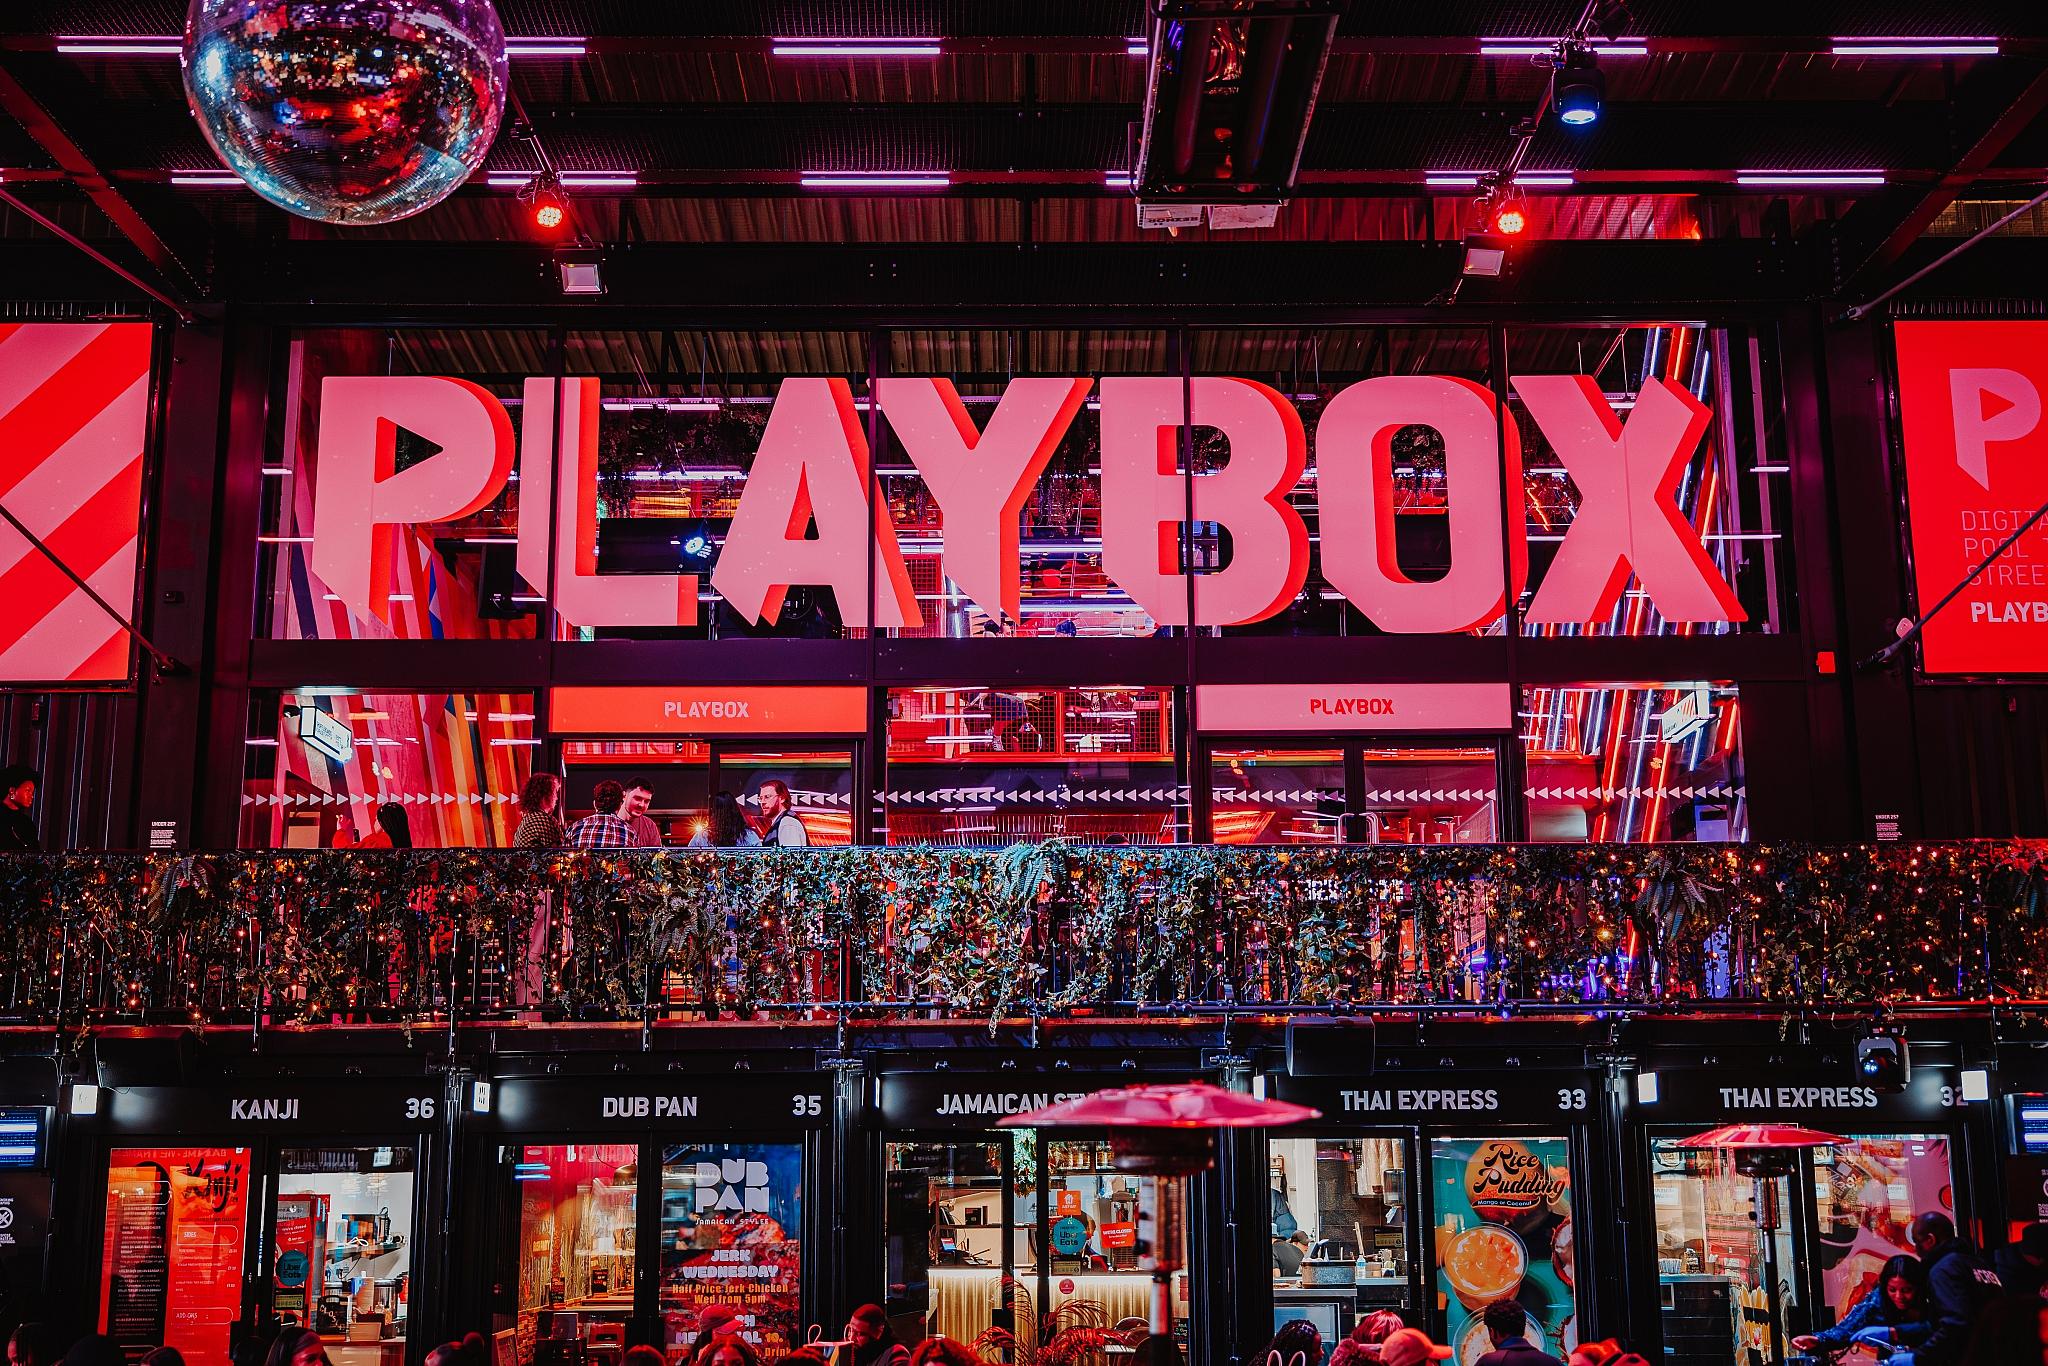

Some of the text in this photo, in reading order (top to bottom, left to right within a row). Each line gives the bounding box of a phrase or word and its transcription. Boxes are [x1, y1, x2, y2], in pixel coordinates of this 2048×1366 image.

[312, 376, 1746, 634] PLAYBOX
[1964, 537, 2029, 558] POOL
[1966, 564, 2048, 586] STREE
[663, 701, 749, 719] PLAYBOX
[1309, 698, 1395, 716] PLAYBOX
[405, 1097, 435, 1119] 36
[603, 1096, 698, 1118] DUB PAN
[792, 1095, 822, 1116] 35
[936, 1093, 1048, 1115] JAMAICAN
[1340, 1089, 1499, 1111] THAI EXPRESS
[1557, 1088, 1586, 1110] 33
[1719, 1086, 1878, 1108] THAI EXPRESS
[231, 1098, 299, 1121] KANJI
[1484, 1143, 1539, 1175] Rice
[696, 1158, 769, 1188] DUB
[1473, 1167, 1566, 1206] Pudding
[696, 1185, 769, 1213] PAN
[711, 1249, 751, 1262] JERK
[682, 1265, 779, 1279] WEDNESDAY
[672, 1284, 693, 1294] Half
[696, 1284, 722, 1293] Price
[748, 1283, 789, 1293] Chicken
[694, 1294, 767, 1305] Wed from 5pm
